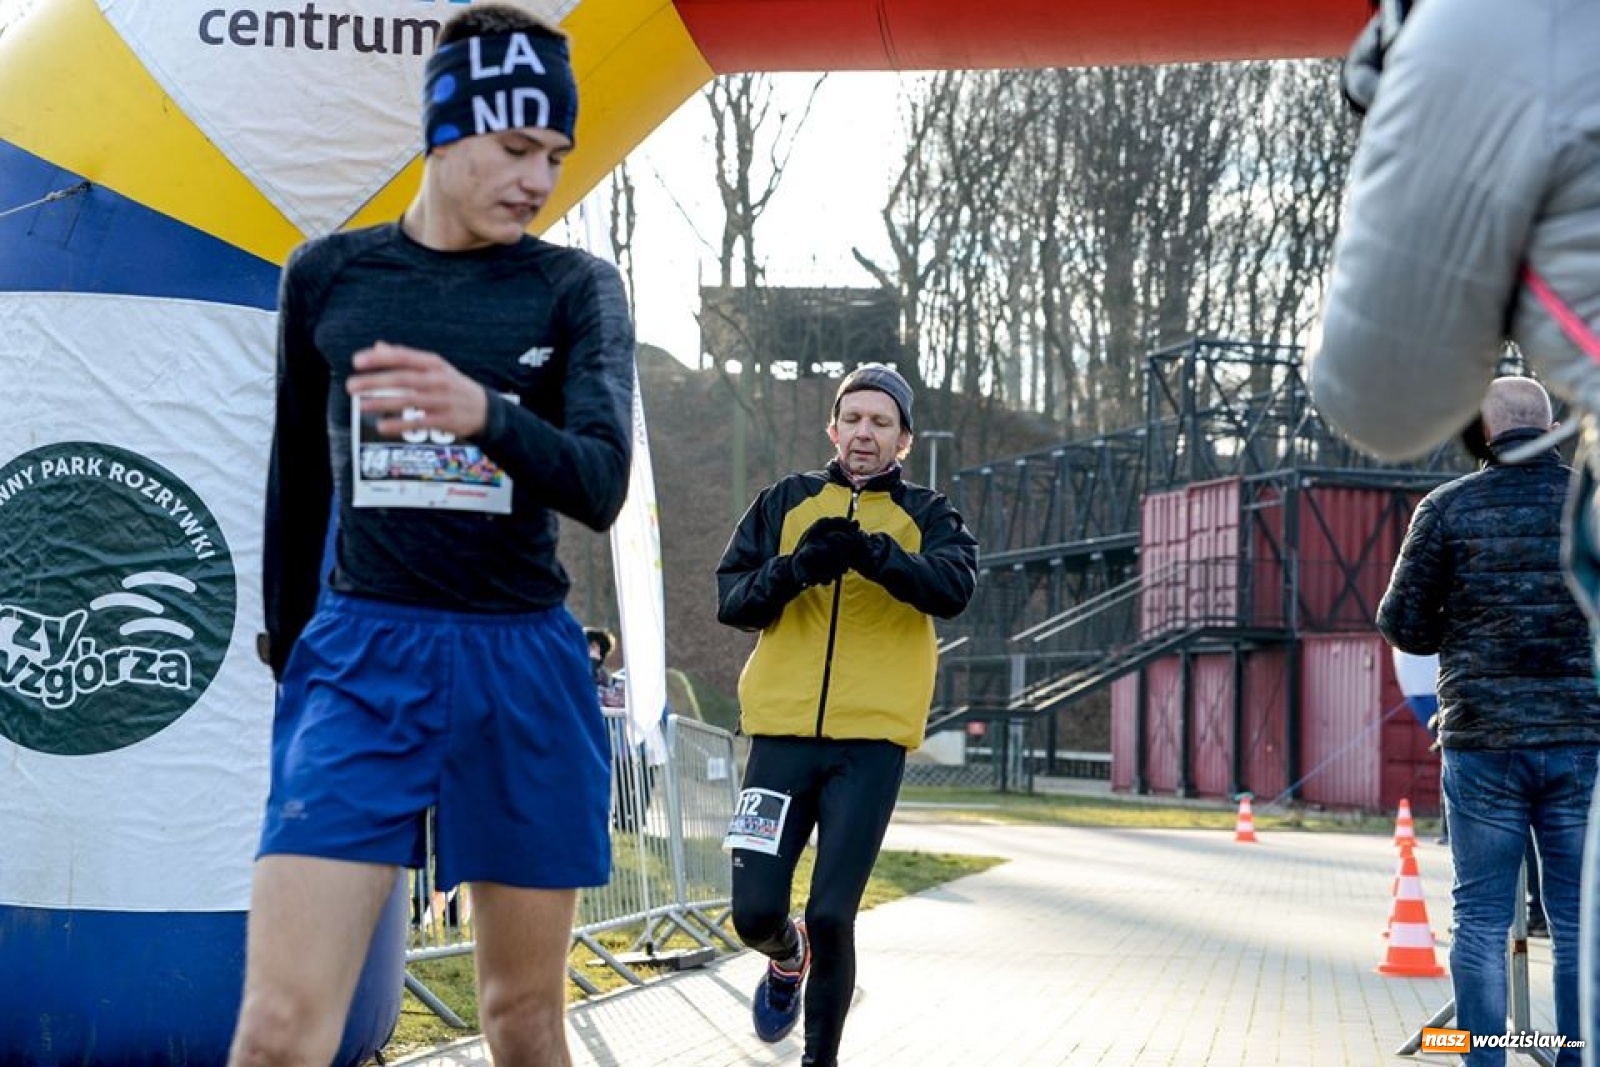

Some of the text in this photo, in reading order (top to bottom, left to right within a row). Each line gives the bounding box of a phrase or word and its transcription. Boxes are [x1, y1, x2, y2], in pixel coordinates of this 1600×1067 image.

[199, 2, 440, 56] centrum
[470, 32, 546, 81] LA
[473, 88, 551, 136] ND
[41, 457, 103, 480] PARK
[109, 462, 217, 561] ROZRYWKI
